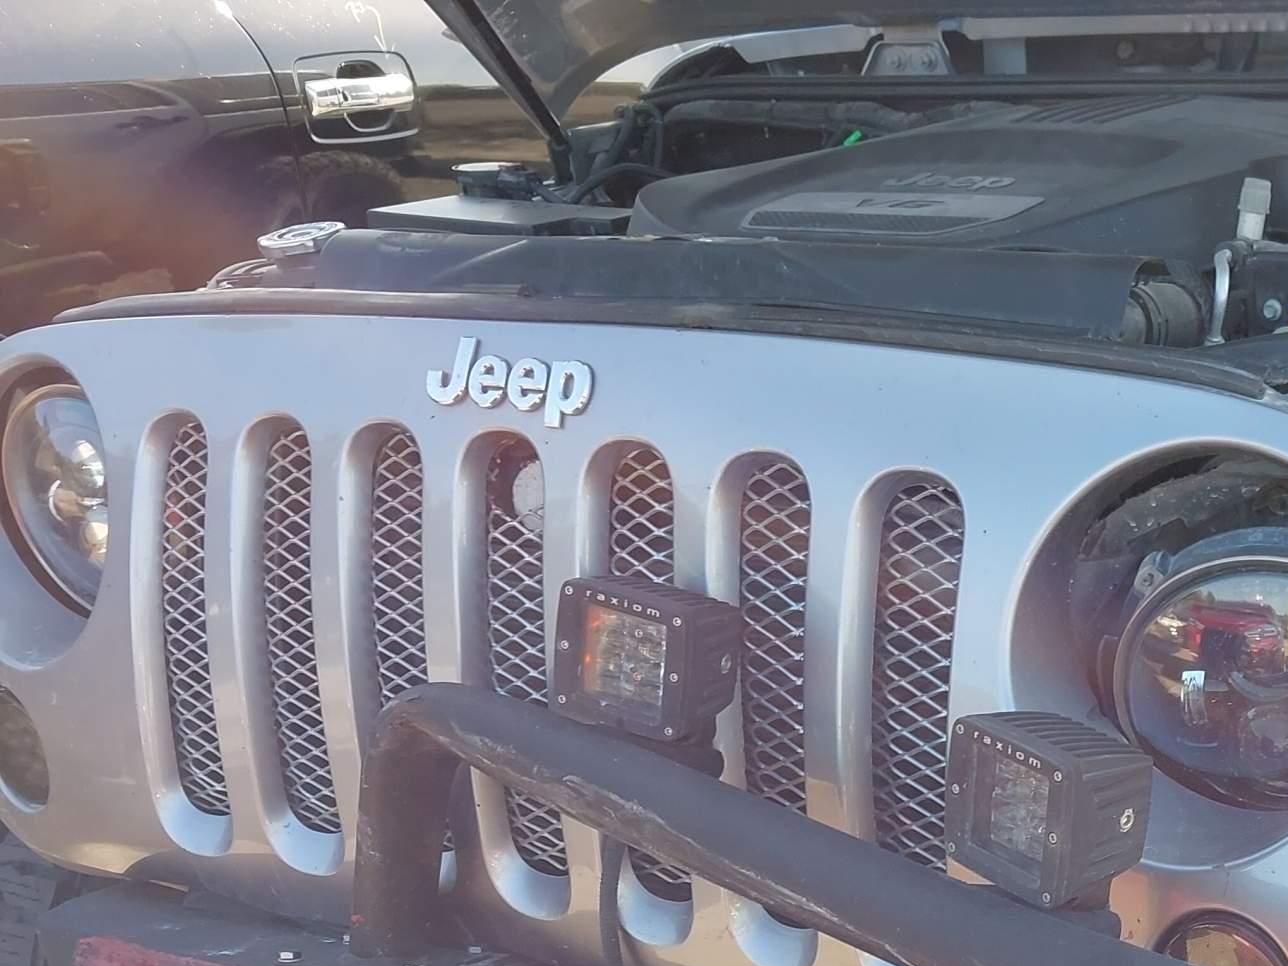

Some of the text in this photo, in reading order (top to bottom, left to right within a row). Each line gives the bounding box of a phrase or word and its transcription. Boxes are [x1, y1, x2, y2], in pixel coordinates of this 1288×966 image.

[426, 336, 595, 429] Jeep
[585, 589, 660, 618] raxiom
[973, 730, 1041, 769] raxiom
